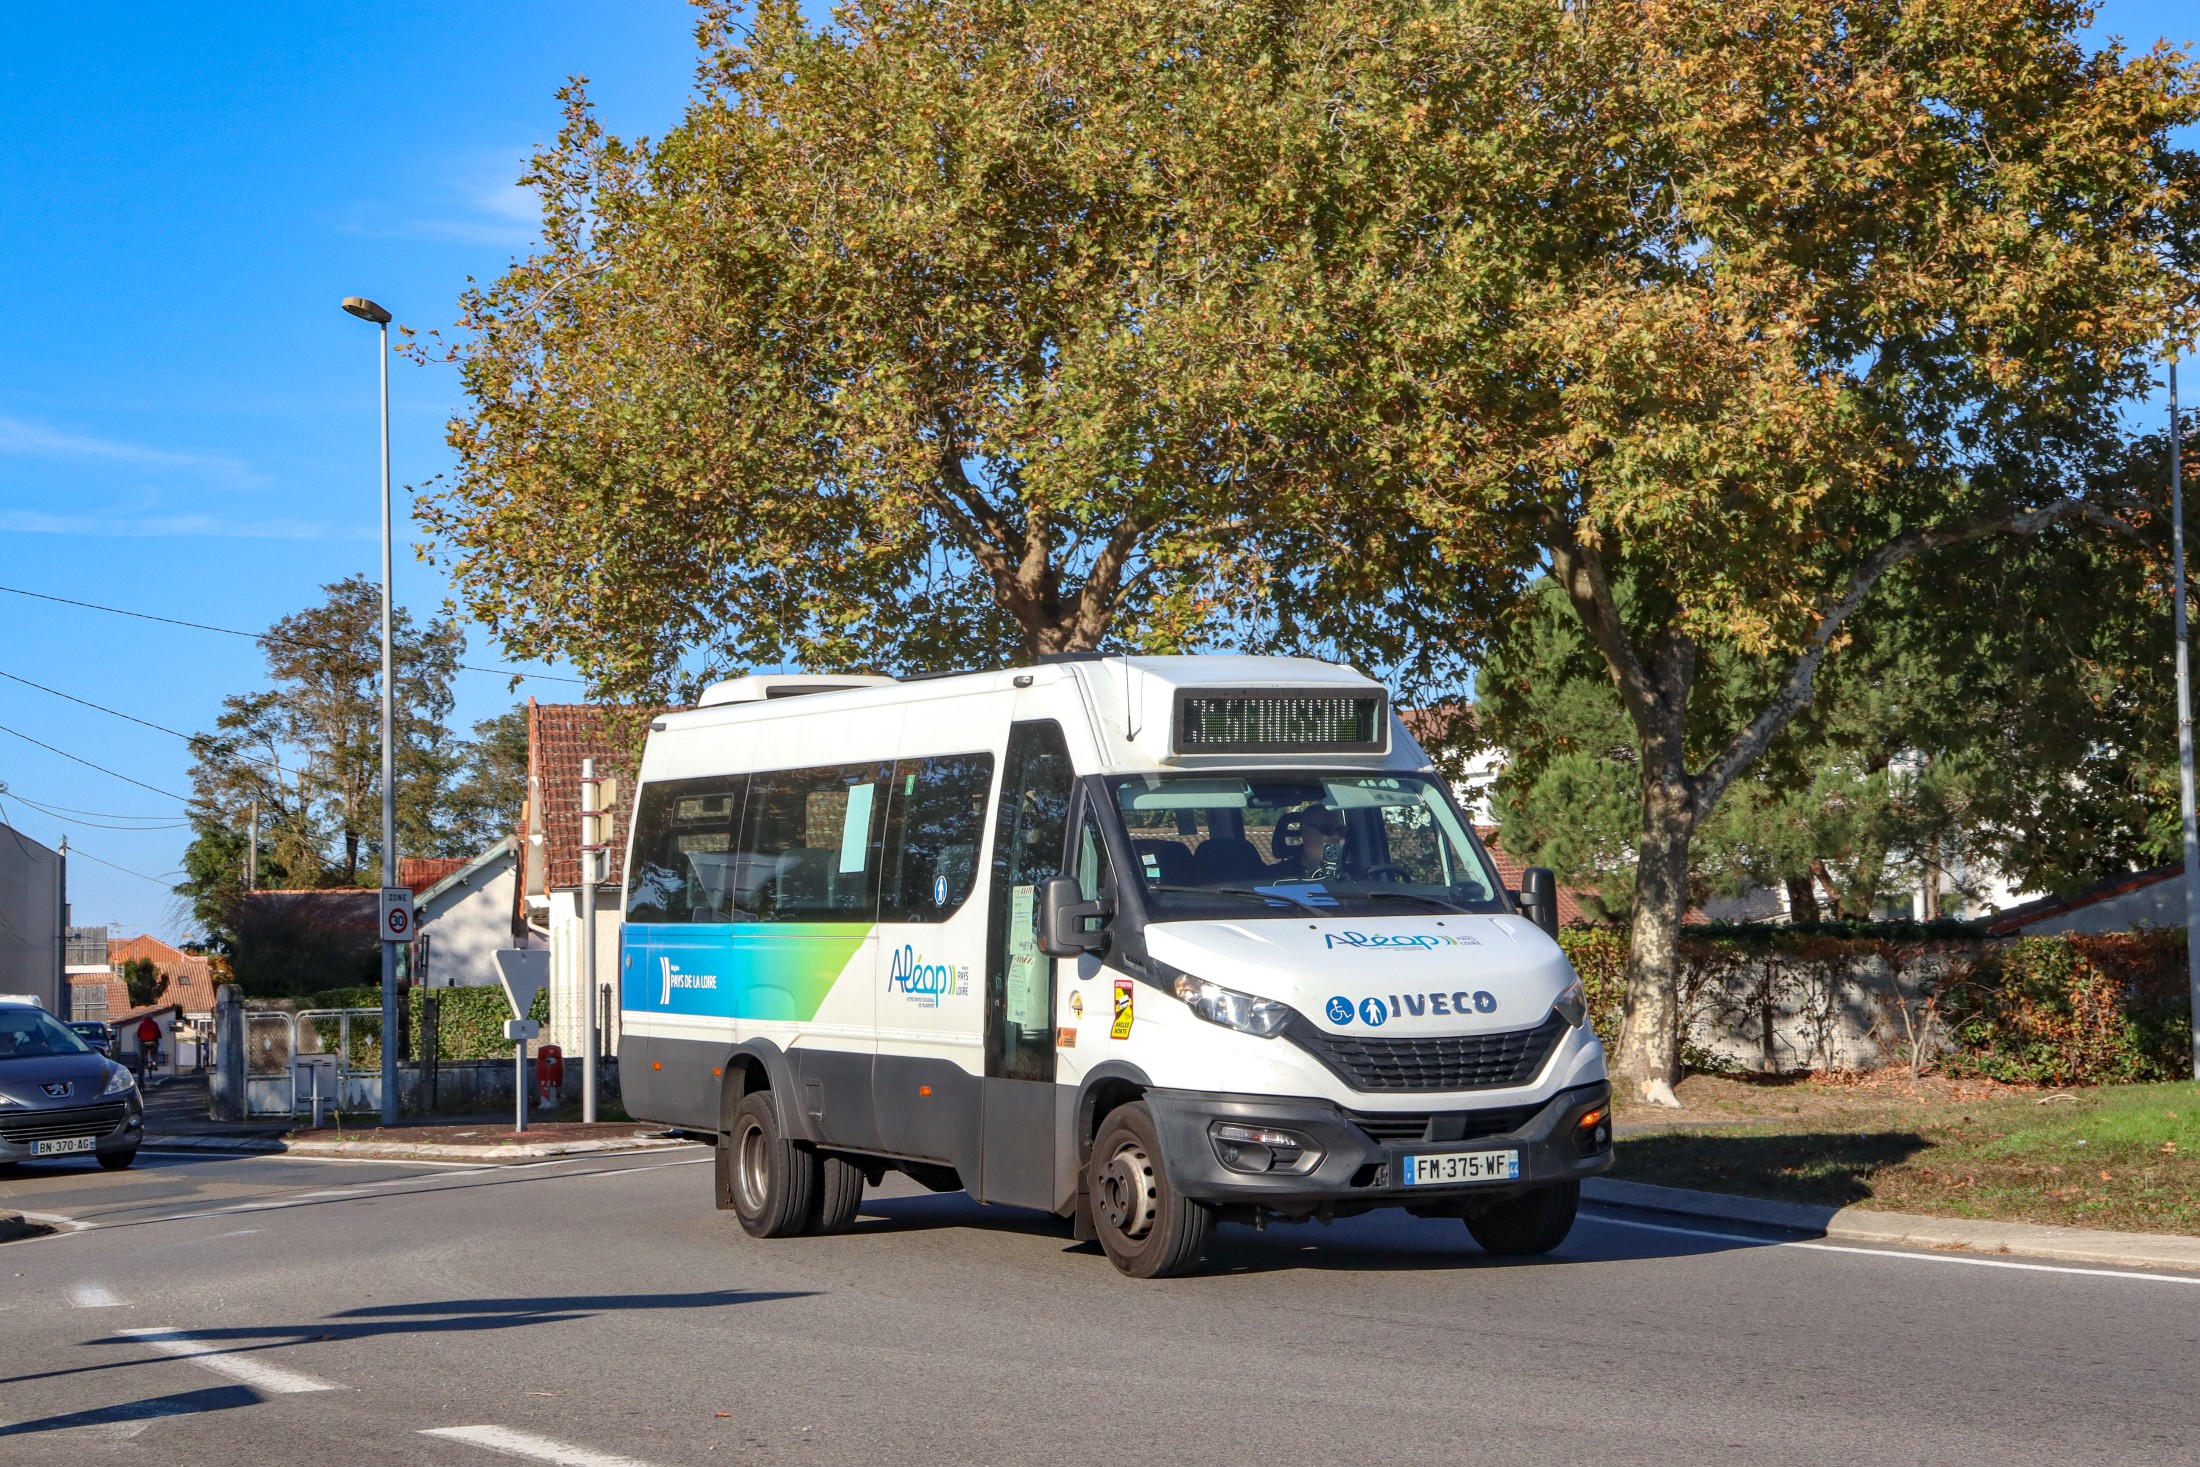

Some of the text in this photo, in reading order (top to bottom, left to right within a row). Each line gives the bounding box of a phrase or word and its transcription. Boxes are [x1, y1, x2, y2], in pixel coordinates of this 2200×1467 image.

[388, 894, 407, 902] ZONE
[392, 915, 404, 926] 30
[670, 974, 717, 989] PAYS DE LA LOIRE
[958, 972, 968, 980] PAYS
[956, 986, 968, 996] LOIRE
[1388, 990, 1498, 1018] IVECO
[40, 1139, 89, 1153] BN-370-AG
[1418, 1154, 1506, 1180] FM-375-WF
[1509, 1164, 1518, 1174] 44
